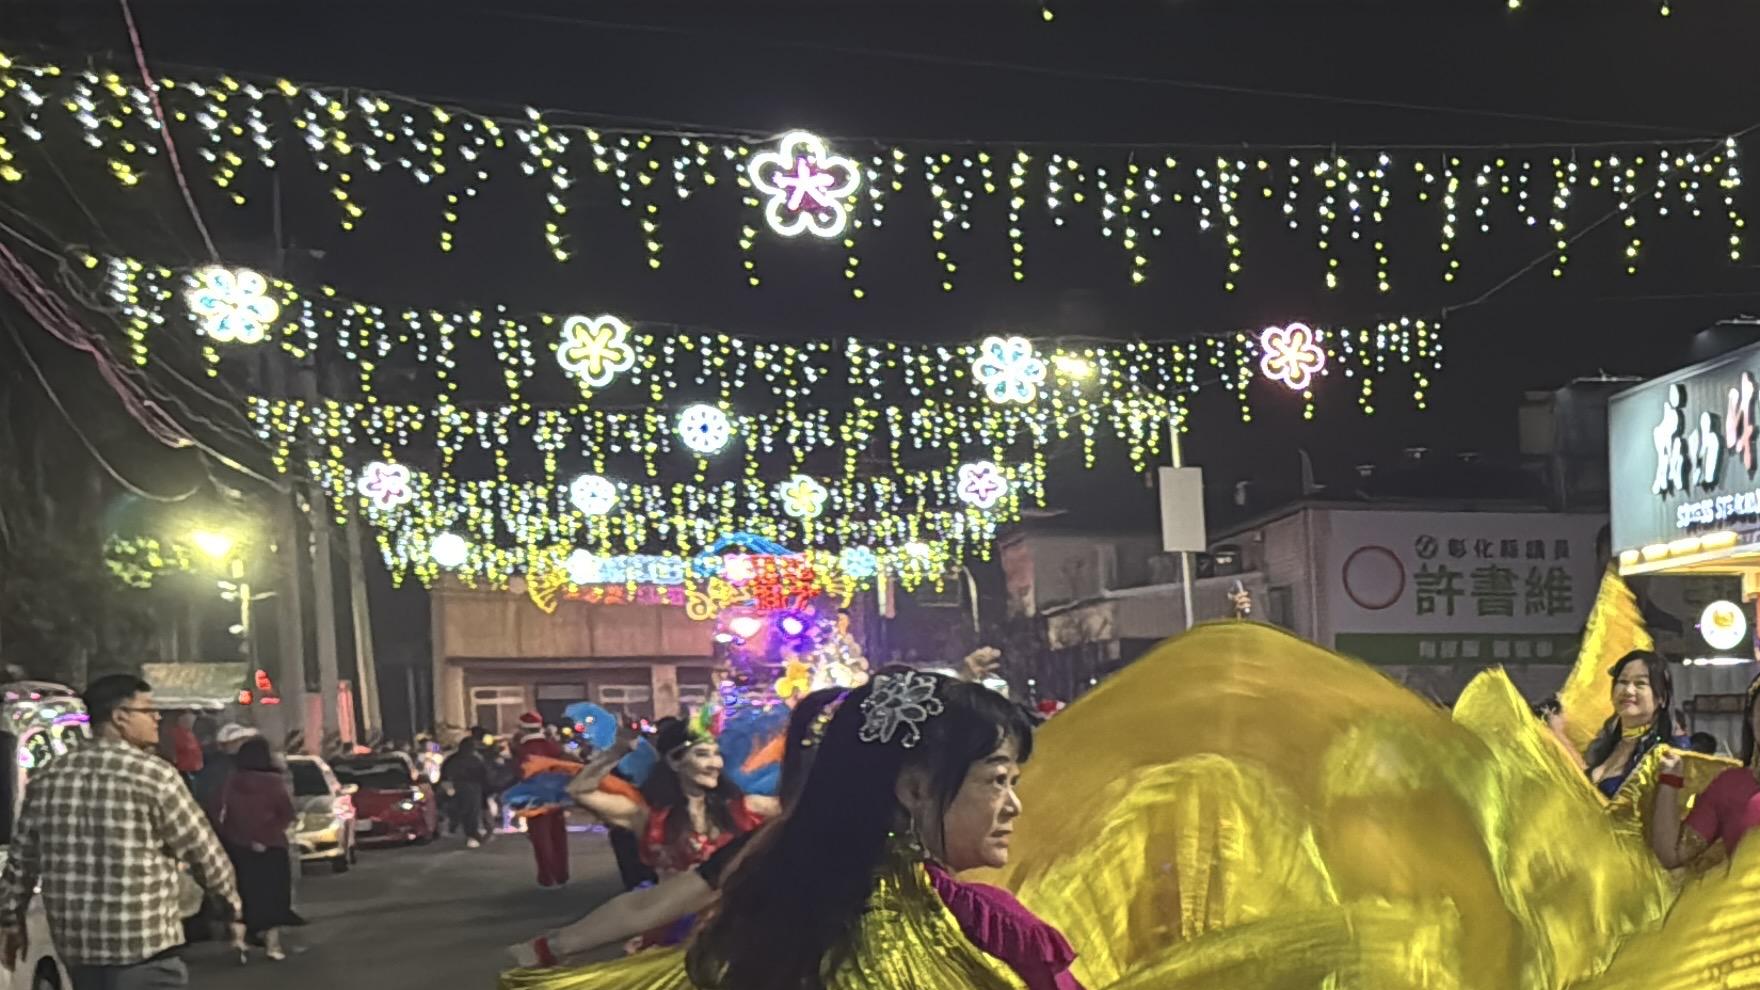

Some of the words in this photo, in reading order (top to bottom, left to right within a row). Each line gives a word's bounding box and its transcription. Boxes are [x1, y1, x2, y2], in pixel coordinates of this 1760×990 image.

[1447, 536, 1571, 559] 彰化縣議員
[1412, 563, 1574, 617] 許書維
